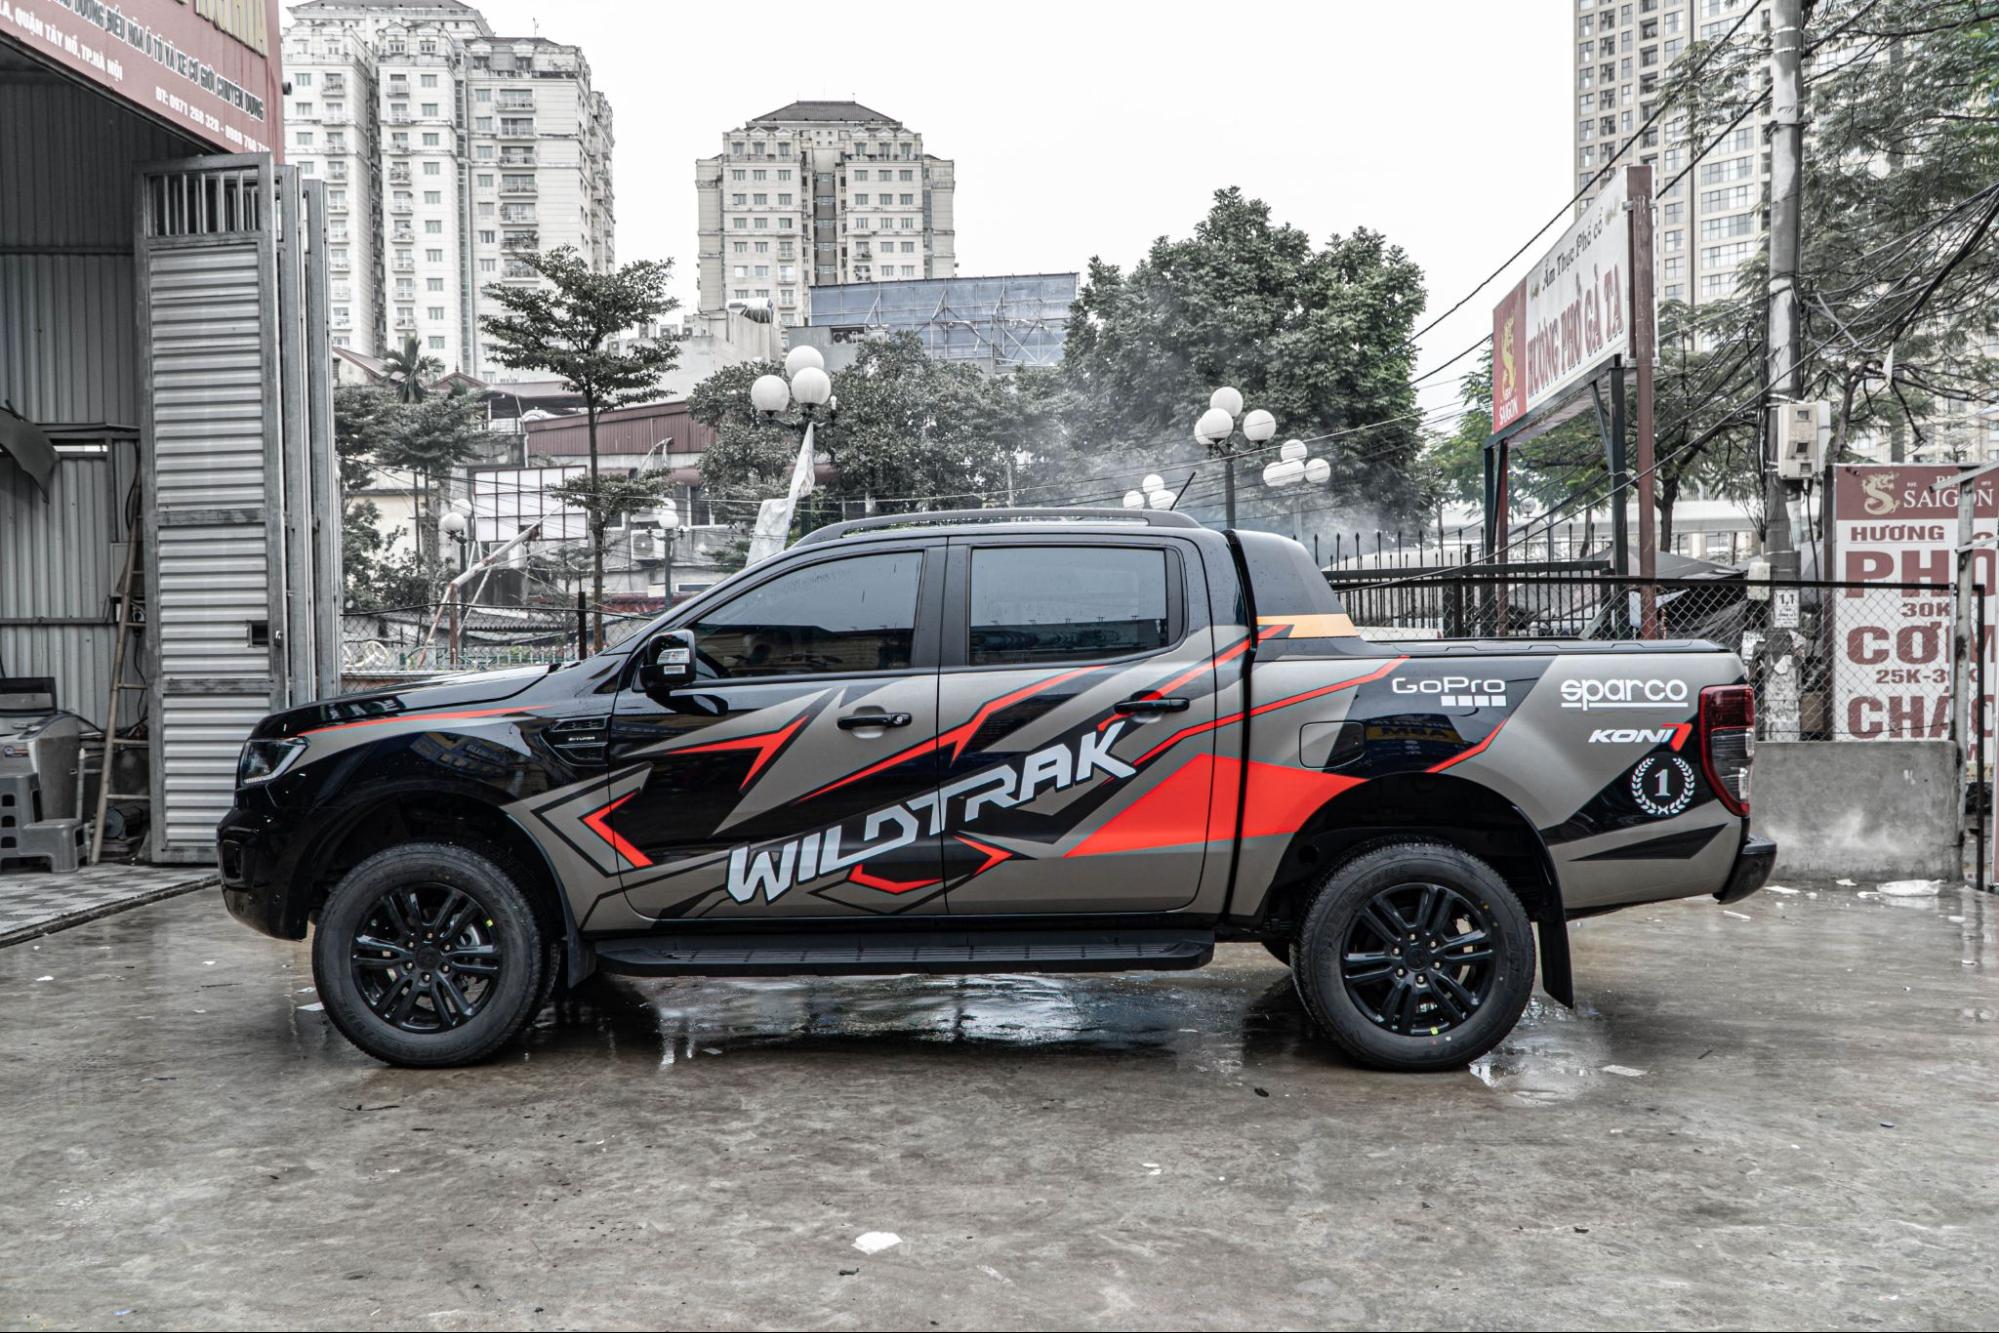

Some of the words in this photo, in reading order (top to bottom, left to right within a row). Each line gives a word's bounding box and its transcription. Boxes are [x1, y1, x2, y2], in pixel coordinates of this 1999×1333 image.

[45, 23, 63, 47] TÂY
[145, 25, 152, 57] Ô
[152, 33, 163, 65] TÔ
[163, 40, 175, 72] VÀ
[1903, 489, 1994, 508] SAIGN
[1850, 525, 1945, 542] HƯƠNG
[1392, 677, 1506, 694] GoPro
[1876, 668, 1979, 684] 25K-3K
[1560, 678, 1689, 711] sparco
[1654, 769, 1672, 797] 1
[726, 719, 1139, 905] WILDTRAK
